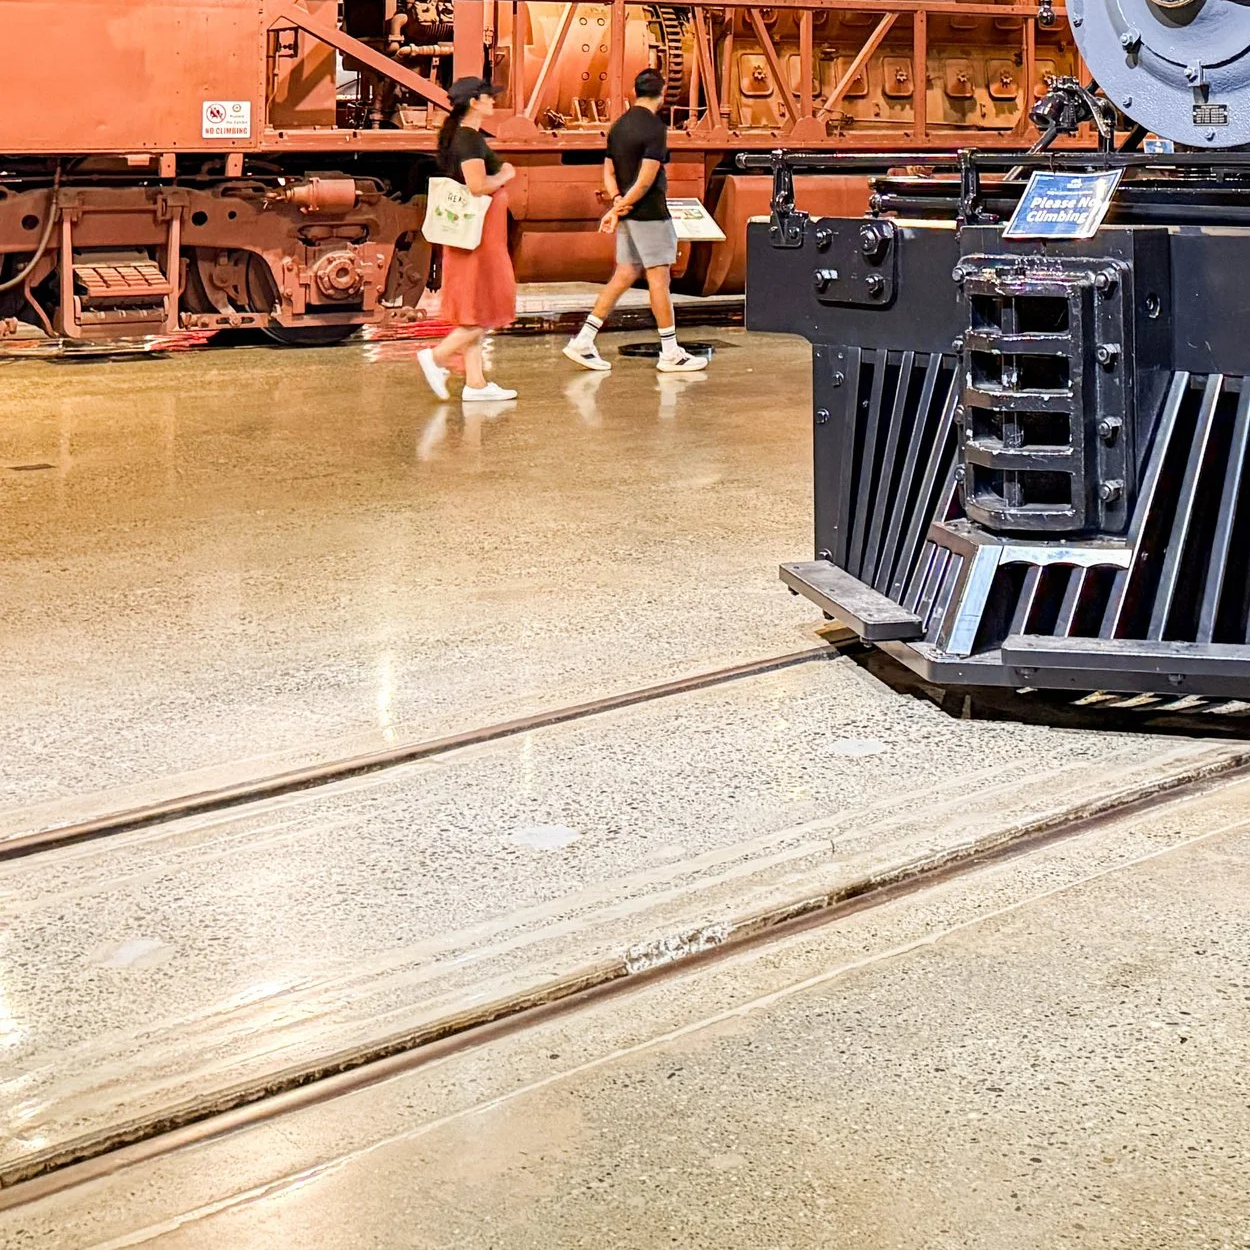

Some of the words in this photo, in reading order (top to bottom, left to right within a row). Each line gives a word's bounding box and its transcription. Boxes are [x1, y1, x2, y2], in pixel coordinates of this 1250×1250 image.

[205, 127, 215, 135] NO
[215, 127, 248, 135] CLIMBING
[1029, 196, 1076, 209] Please
[1026, 209, 1088, 225] Climbing
